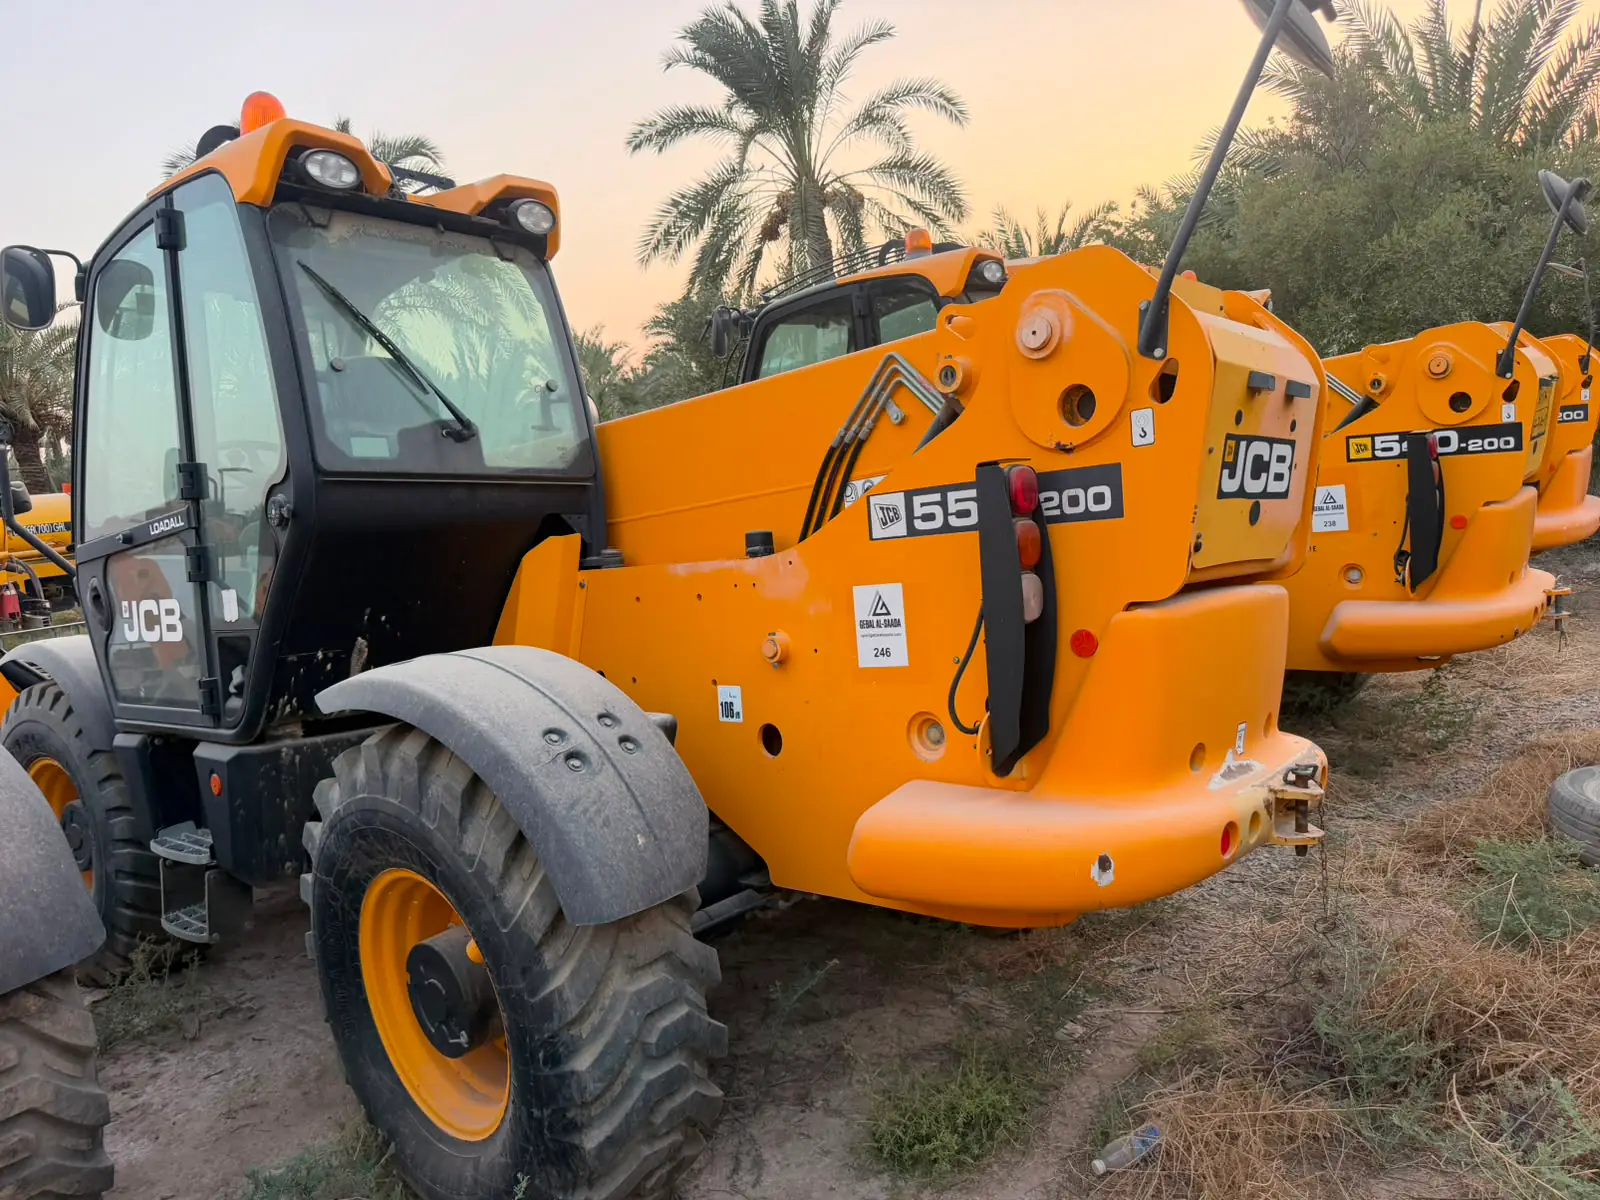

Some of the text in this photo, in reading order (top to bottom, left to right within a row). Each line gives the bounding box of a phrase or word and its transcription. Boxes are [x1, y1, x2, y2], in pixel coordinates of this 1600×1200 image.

[1374, 430, 1515, 458] 50-200
[1221, 440, 1293, 493] JCB
[149, 515, 185, 535] LOADALL
[879, 506, 901, 527] JCB
[1323, 520, 1337, 528] 238
[123, 598, 183, 642] JCB
[859, 618, 902, 629] GEBAL AL-SAADA
[873, 647, 892, 658] 246
[720, 701, 735, 718] 106
